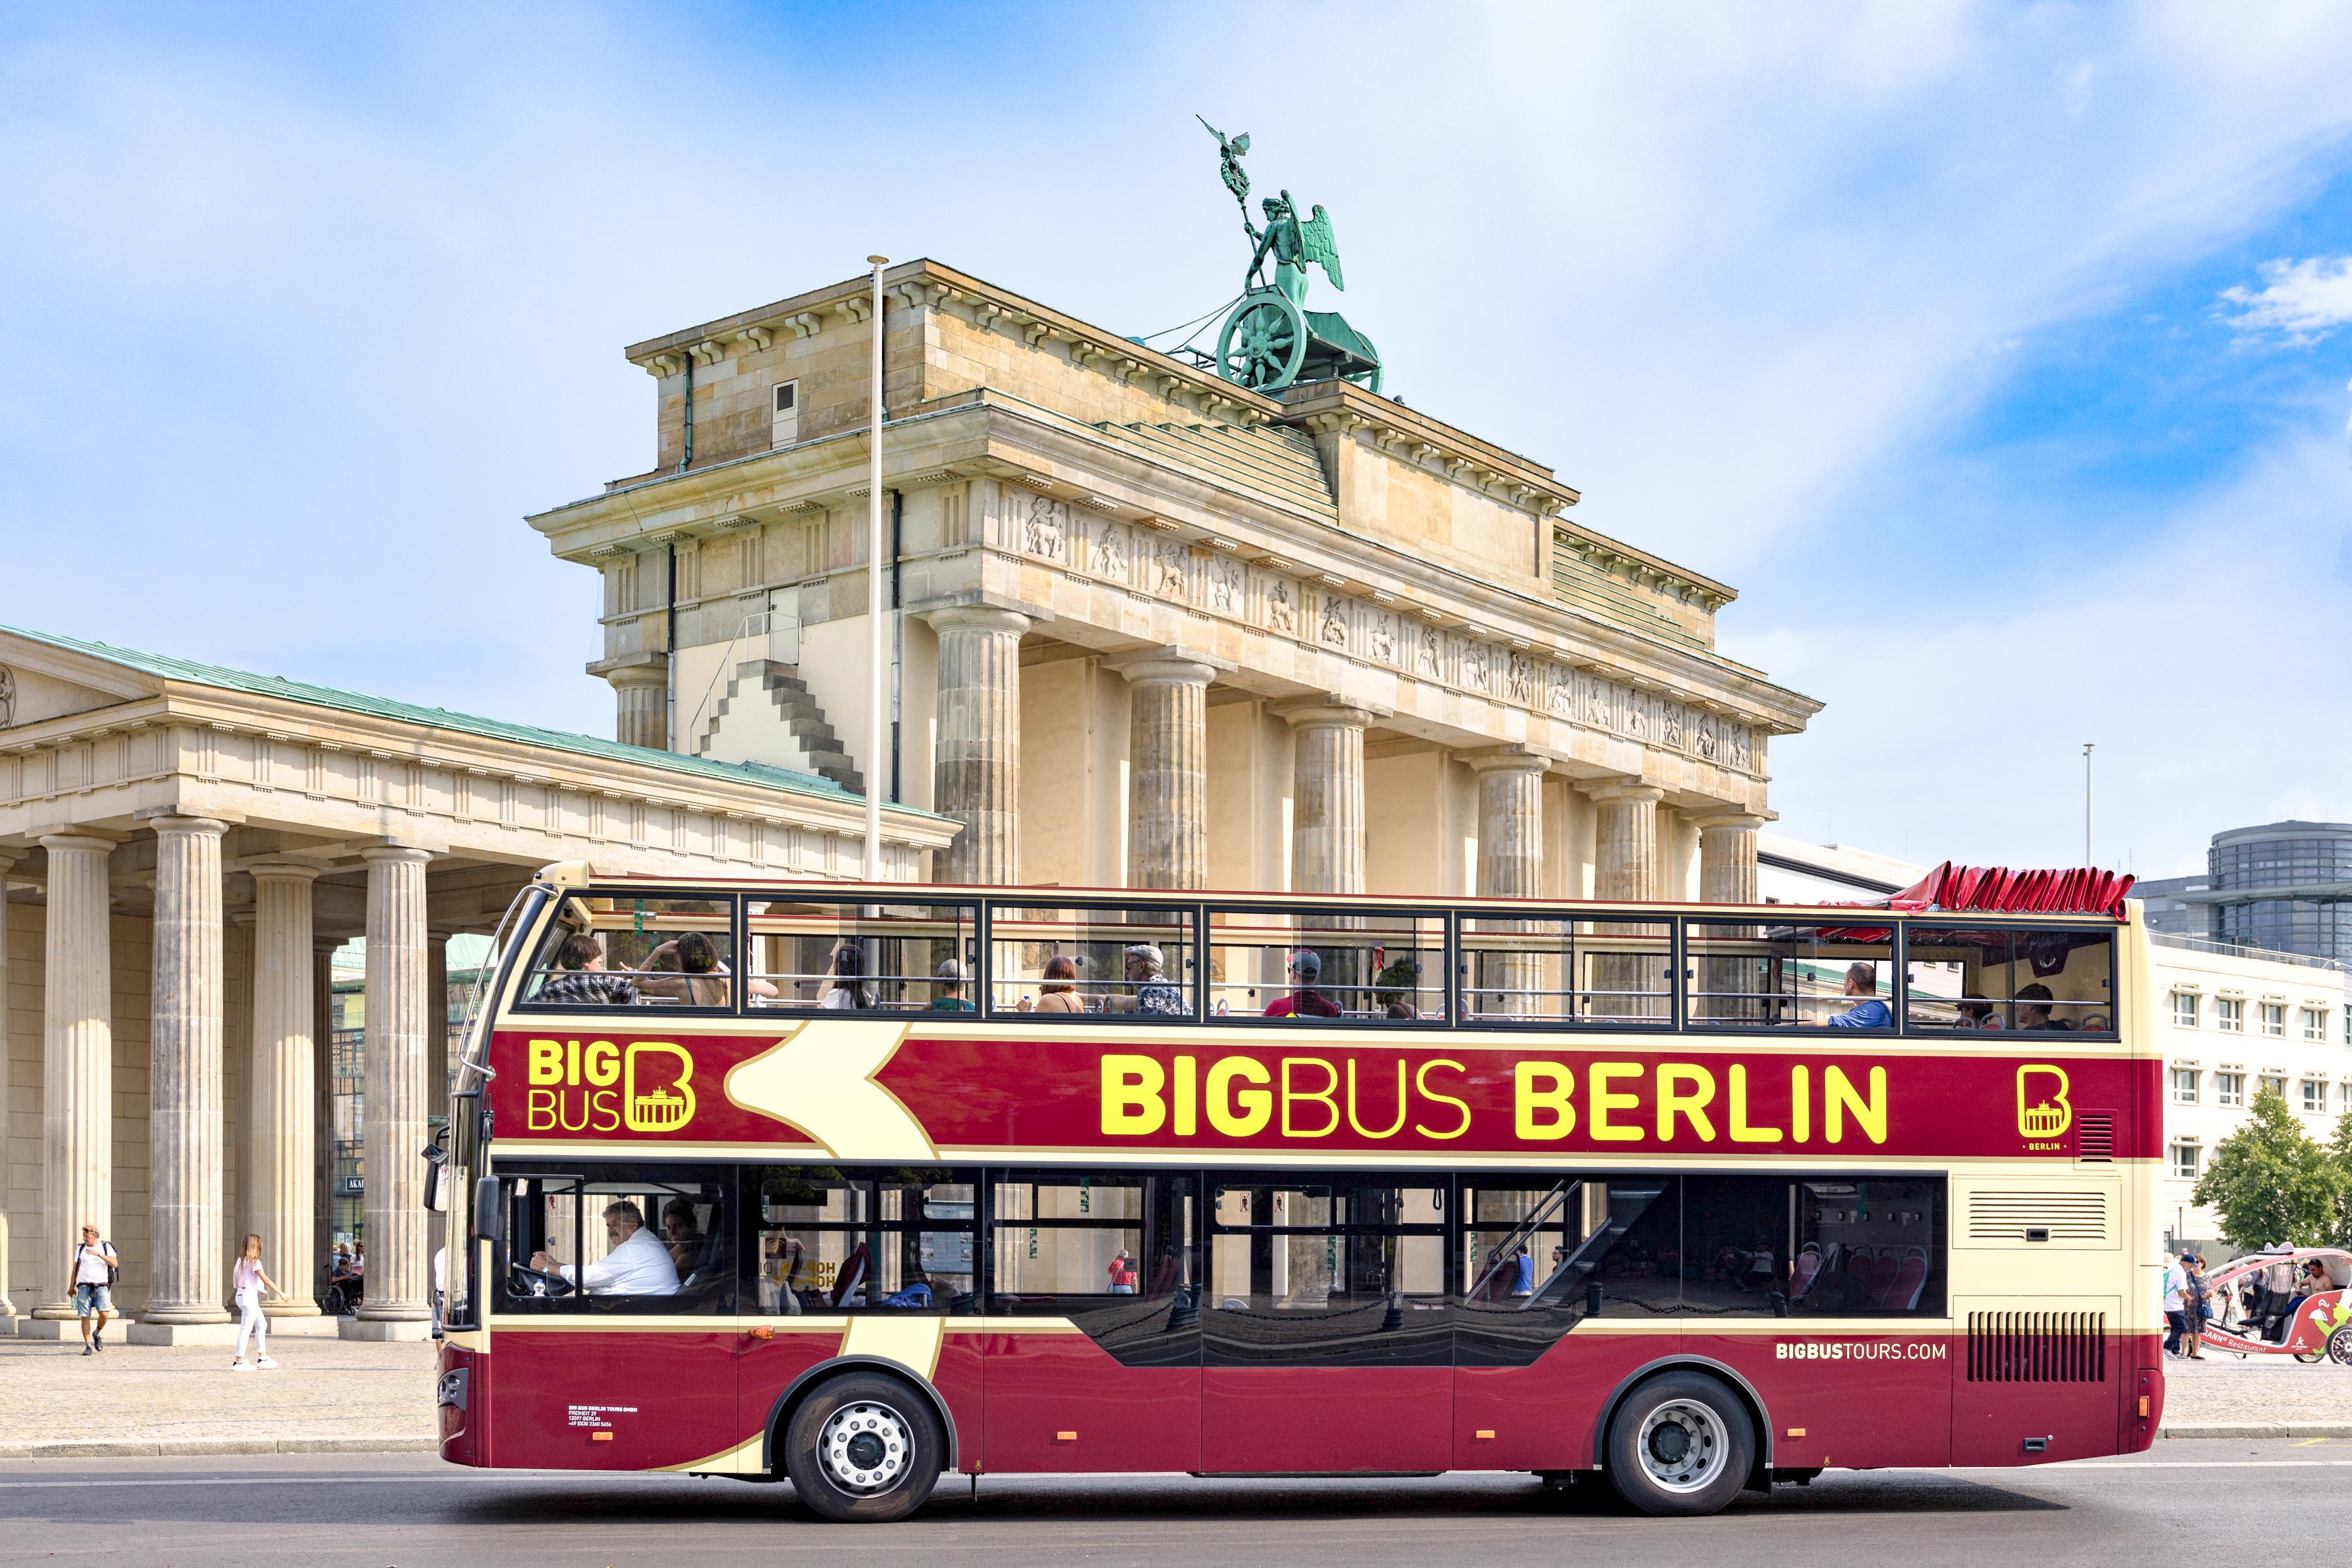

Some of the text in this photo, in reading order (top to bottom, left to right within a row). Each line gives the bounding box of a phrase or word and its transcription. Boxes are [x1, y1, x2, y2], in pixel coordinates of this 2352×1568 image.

[529, 1039, 620, 1086] BIG
[528, 1089, 620, 1131] BUS
[1514, 1061, 1887, 1144] BERLIN
[1776, 1343, 1946, 1360] BIGBUSTOURS.COM
[2227, 1339, 2266, 1352] Restaurant
